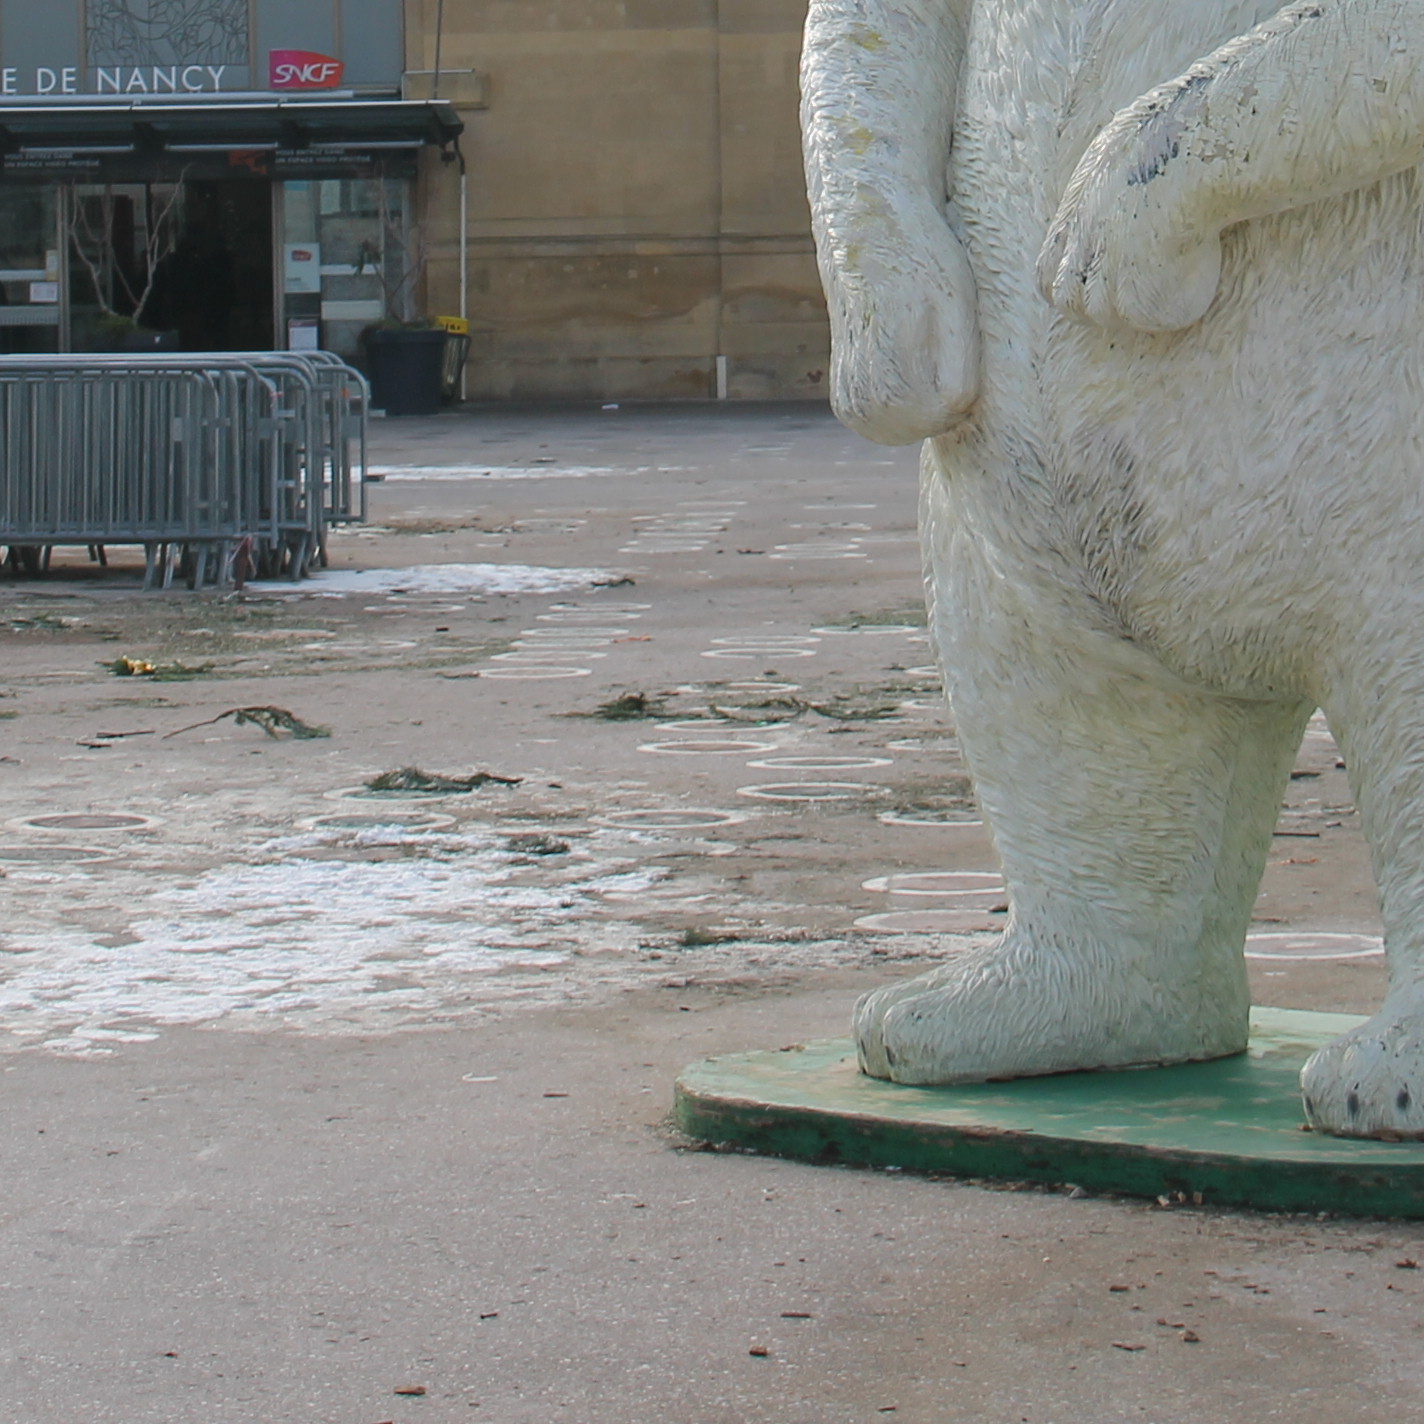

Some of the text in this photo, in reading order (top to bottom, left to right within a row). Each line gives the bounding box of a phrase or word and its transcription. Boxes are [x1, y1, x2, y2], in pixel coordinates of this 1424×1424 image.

[36, 67, 76, 94] DE
[97, 65, 226, 94] NANCY
[273, 63, 341, 84] SNCF
